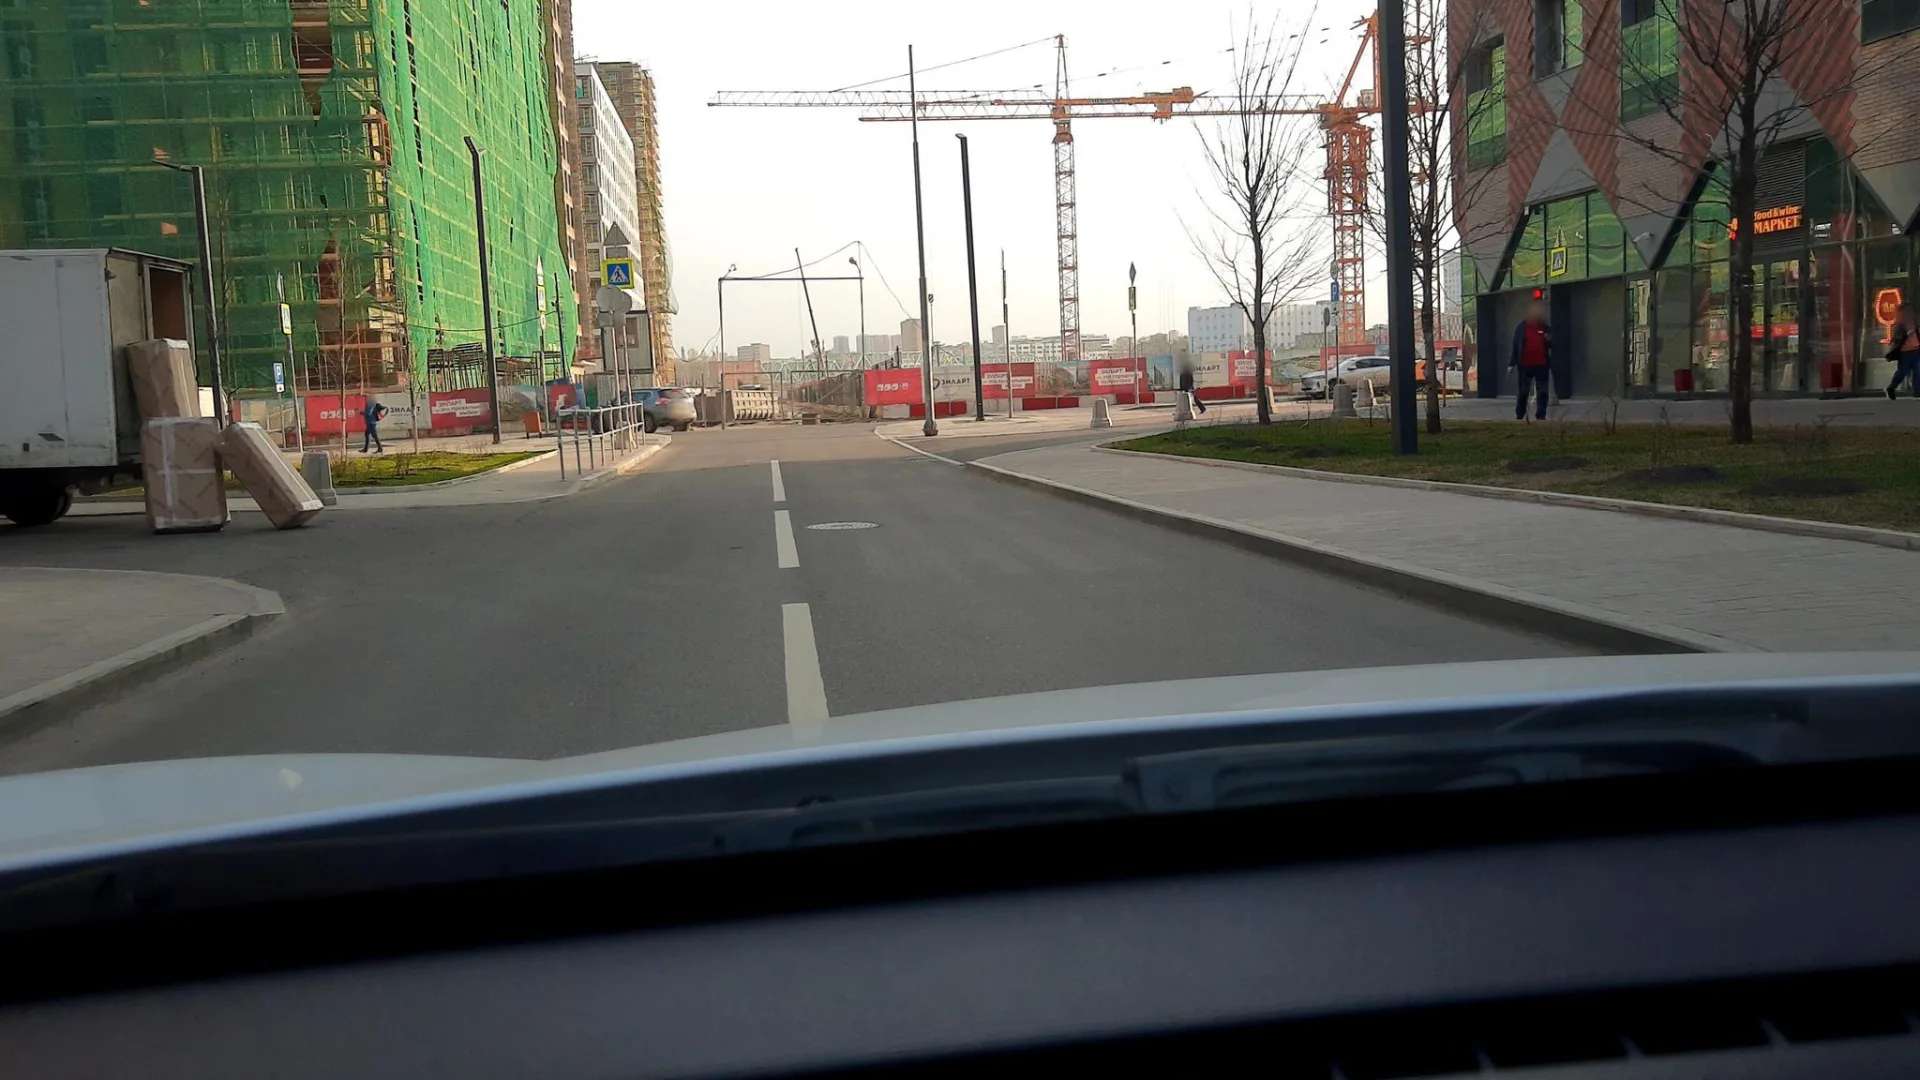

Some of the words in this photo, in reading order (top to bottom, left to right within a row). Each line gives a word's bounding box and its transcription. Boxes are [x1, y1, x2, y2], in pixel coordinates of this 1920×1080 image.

[1754, 215, 1800, 235] МАРКЕТ
[941, 377, 970, 386] ЗИЛАРТ
[390, 406, 421, 414] ЗИЛАТ
